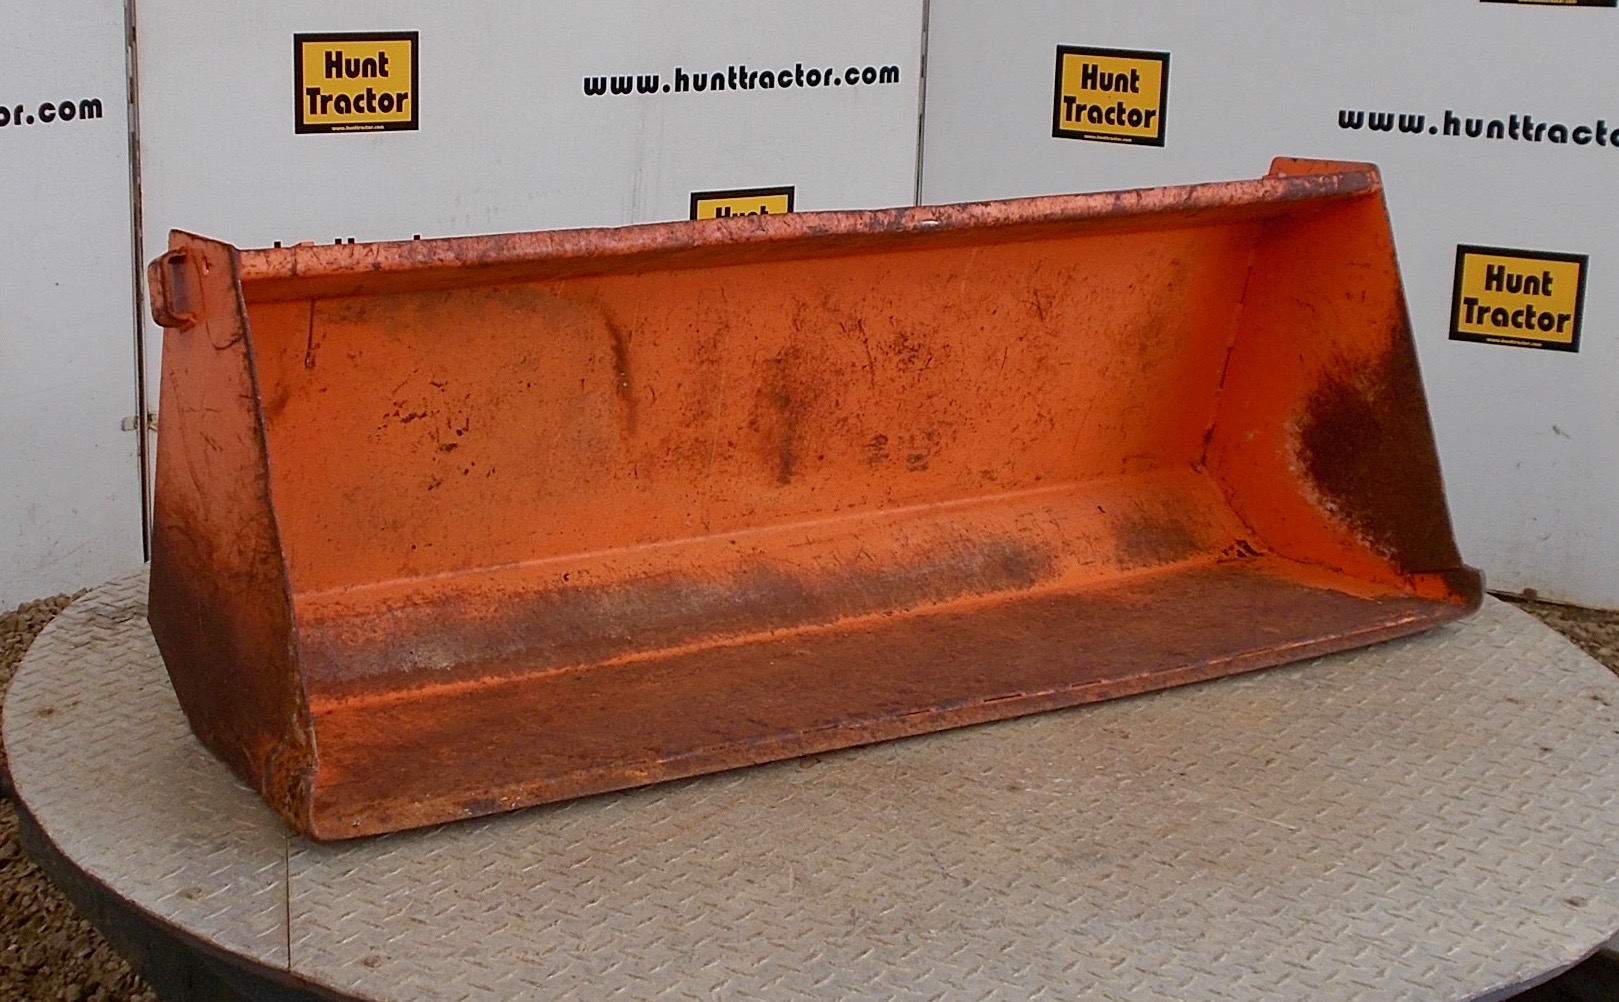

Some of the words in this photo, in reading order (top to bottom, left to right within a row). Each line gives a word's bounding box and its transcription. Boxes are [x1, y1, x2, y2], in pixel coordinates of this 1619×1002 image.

[325, 51, 389, 78] Hunt
[584, 63, 900, 96] www.hunttractor.com
[1081, 63, 1140, 93] Hunt
[306, 87, 409, 114] Tractor
[1063, 95, 1157, 128] Tractor
[1485, 264, 1554, 296] Hunt
[1463, 297, 1572, 333] Tractor
